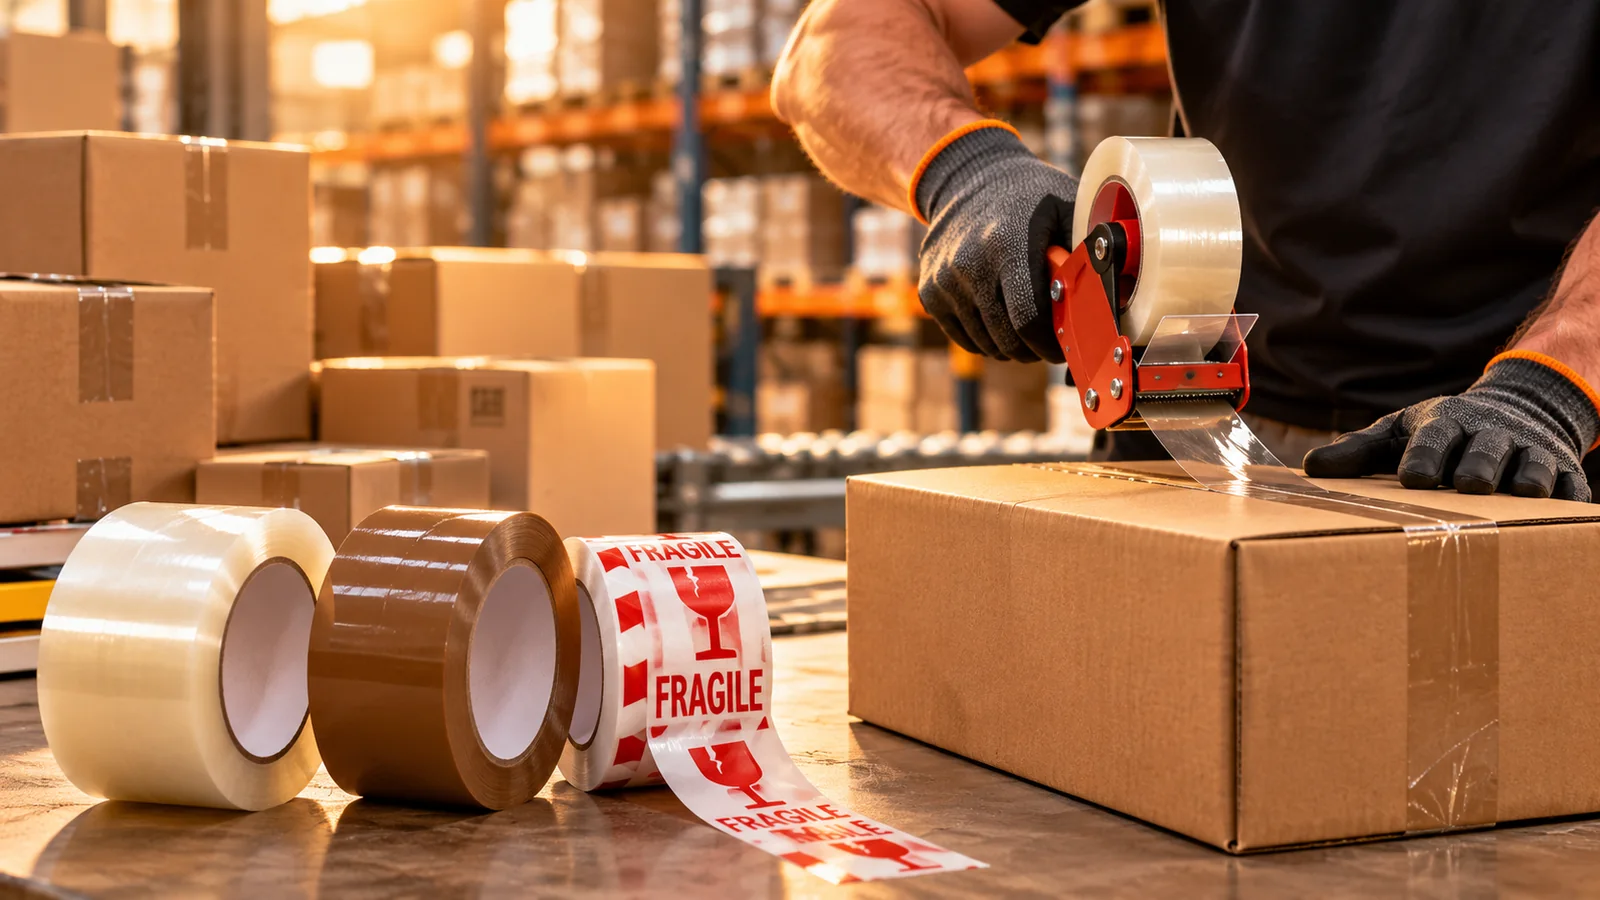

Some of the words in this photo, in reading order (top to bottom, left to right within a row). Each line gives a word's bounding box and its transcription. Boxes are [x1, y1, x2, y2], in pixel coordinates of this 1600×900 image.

[625, 540, 742, 563] FRAGILE
[655, 668, 764, 719] FRAGILE
[715, 804, 851, 833] FRAGILE
